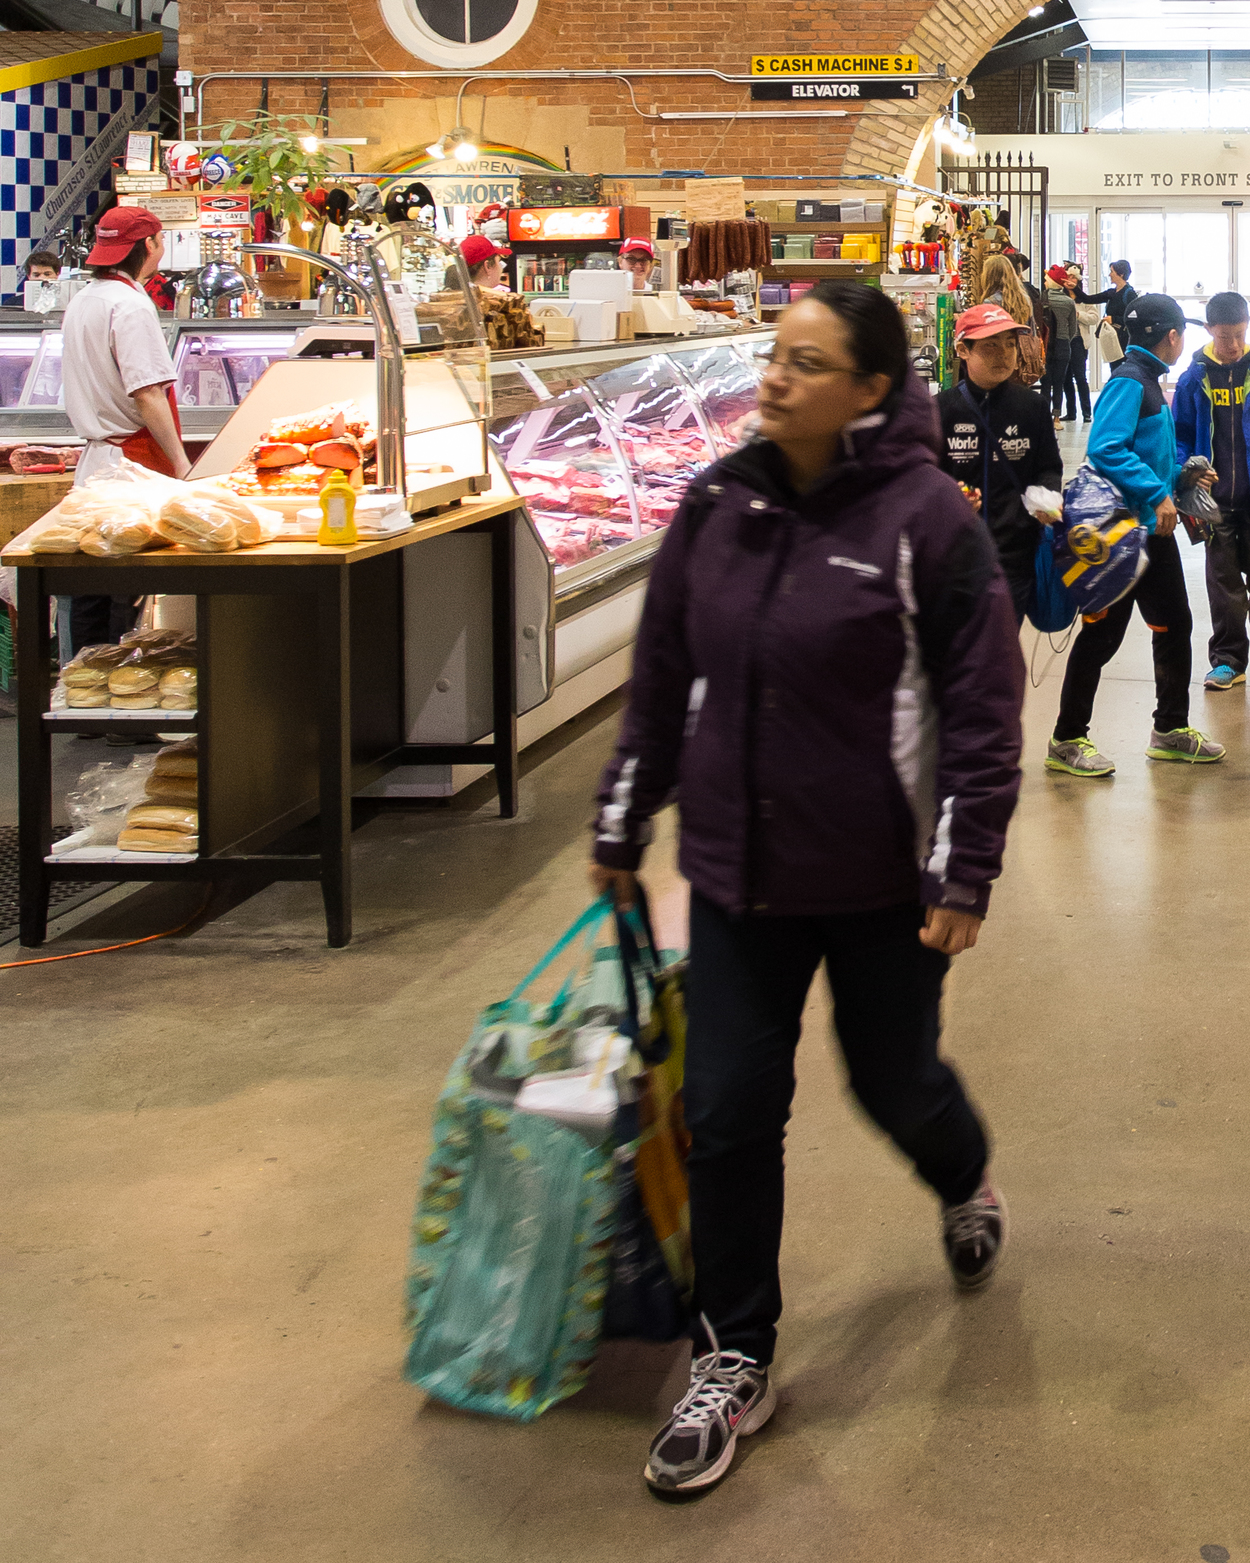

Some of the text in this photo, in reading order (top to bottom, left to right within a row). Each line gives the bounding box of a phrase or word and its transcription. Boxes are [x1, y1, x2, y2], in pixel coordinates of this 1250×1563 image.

[756, 58, 902, 72] $ CASH MACHINE $
[792, 84, 860, 97] ELEVATOR
[1104, 173, 1144, 187] EXIT
[1151, 173, 1173, 187] TO
[1180, 173, 1238, 187] FRONT
[45, 167, 86, 219] Churrasco
[947, 436, 979, 450] World
[998, 437, 1031, 453] aepa
